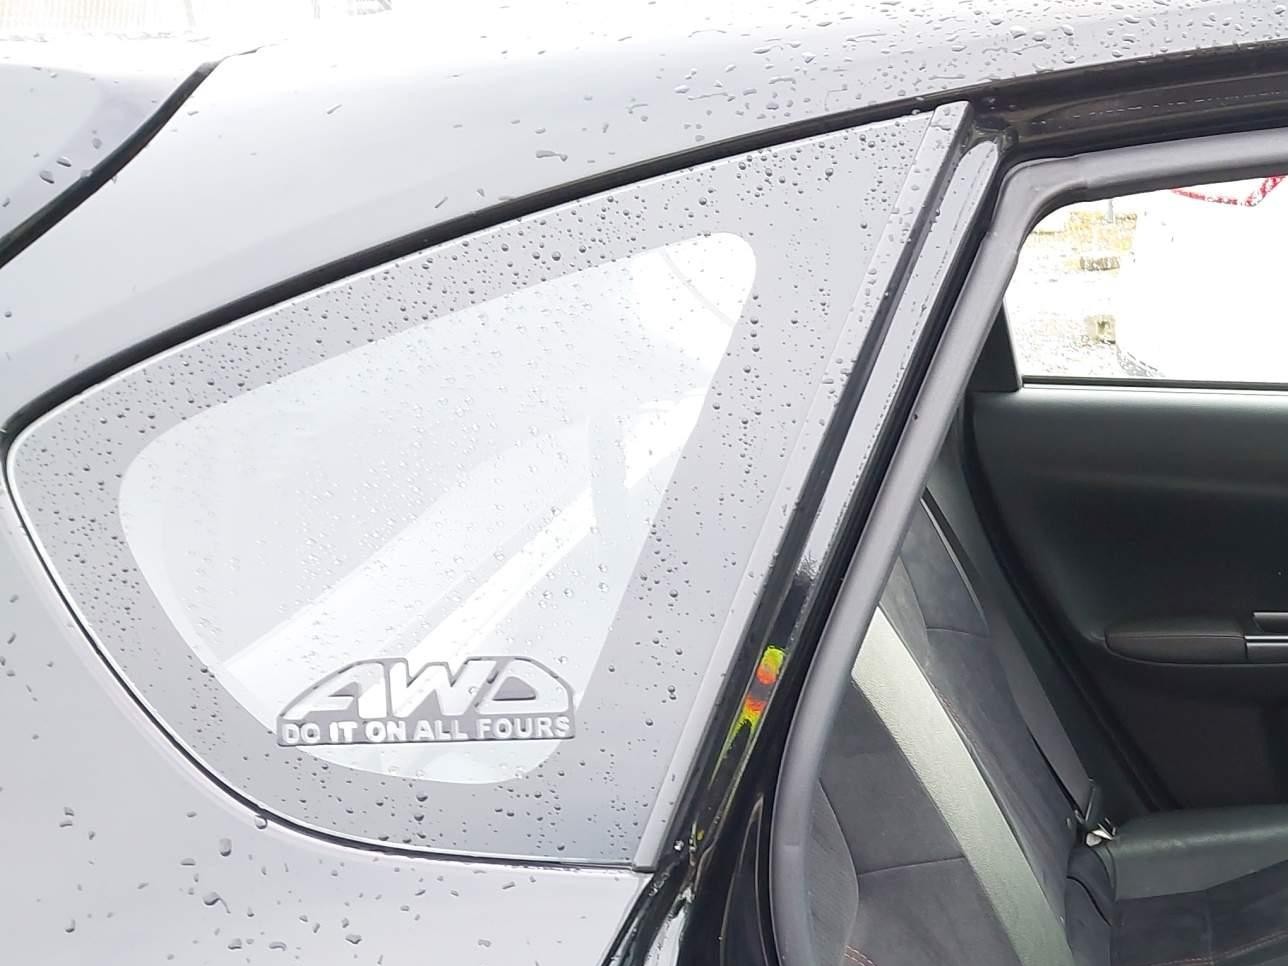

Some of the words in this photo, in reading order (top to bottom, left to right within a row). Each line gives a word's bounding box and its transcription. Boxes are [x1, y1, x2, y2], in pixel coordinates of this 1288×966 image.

[280, 657, 572, 719] AWD
[281, 722, 321, 744] DO
[328, 721, 358, 742] IT
[365, 720, 406, 742] ON
[413, 719, 469, 741] ALL
[478, 716, 571, 739] FOURS
